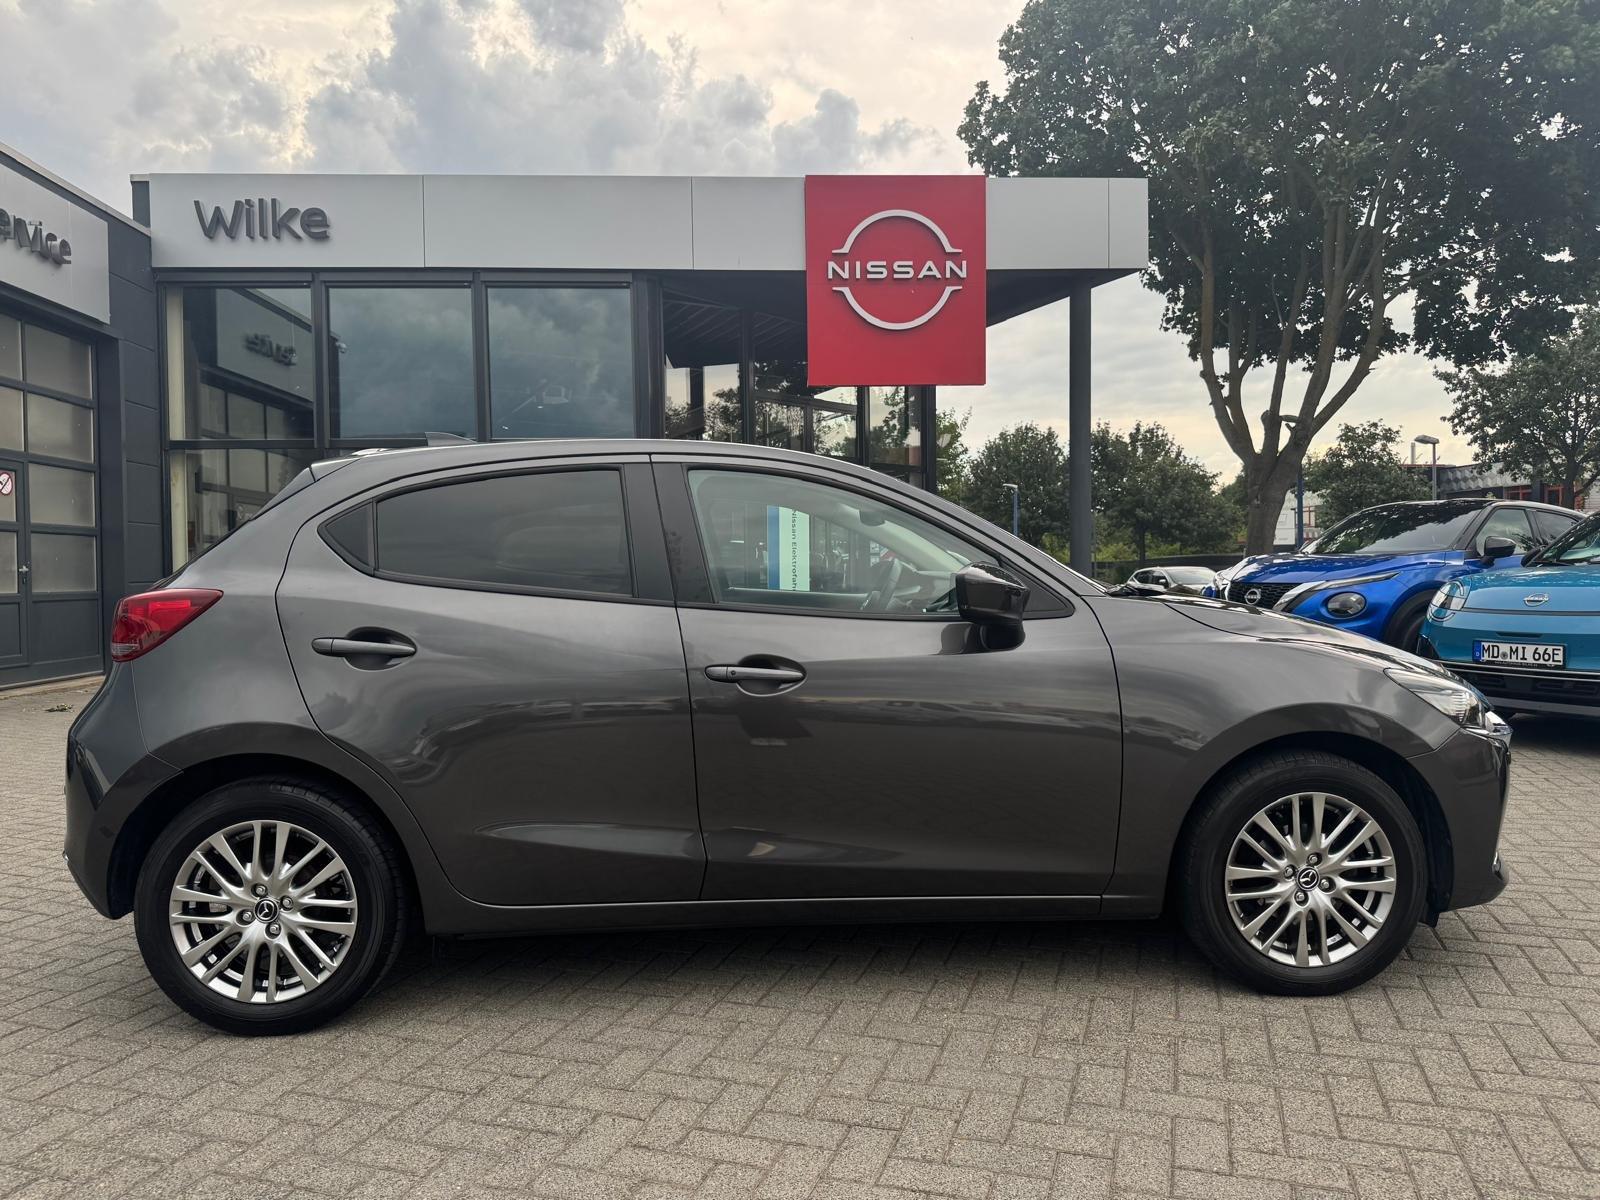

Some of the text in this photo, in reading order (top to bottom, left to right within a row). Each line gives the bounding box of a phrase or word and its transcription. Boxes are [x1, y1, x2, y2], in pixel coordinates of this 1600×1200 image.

[194, 198, 330, 241] Wilke
[827, 260, 967, 279] NISSAN
[791, 542, 799, 591] Elektrofah
[1482, 644, 1500, 659] MD
[1509, 646, 1527, 661] MI
[1532, 647, 1561, 663] 66E
